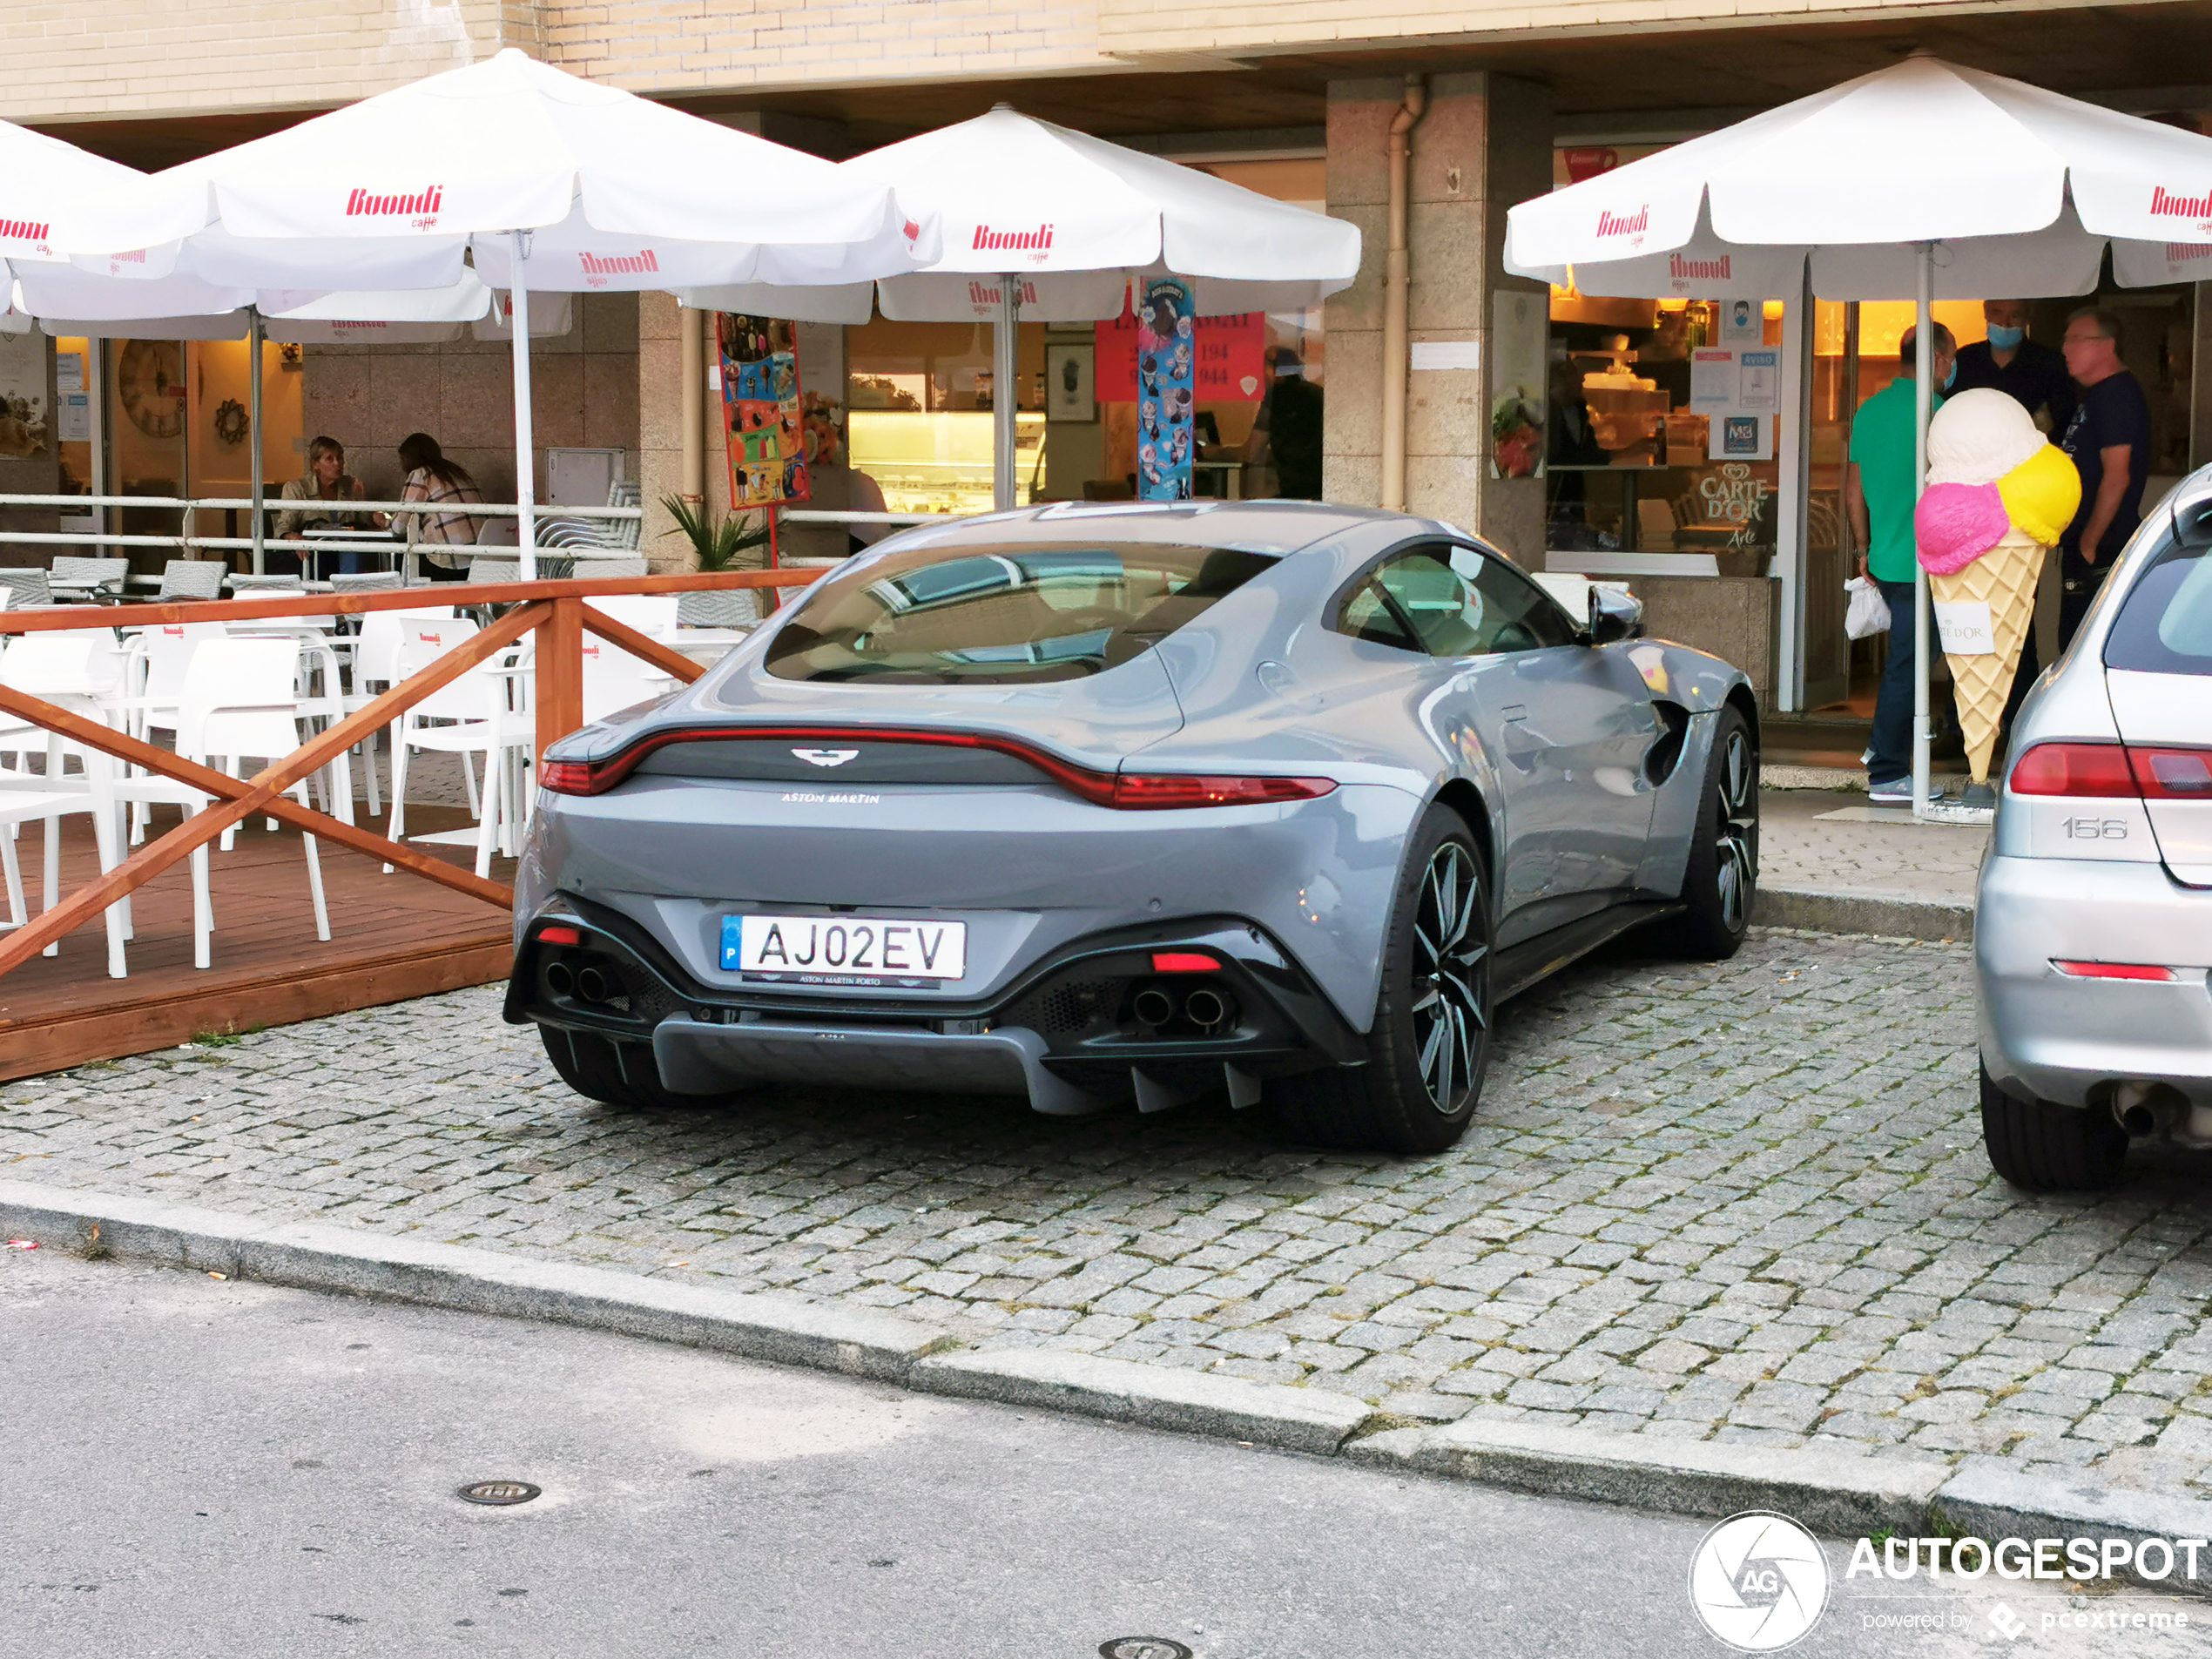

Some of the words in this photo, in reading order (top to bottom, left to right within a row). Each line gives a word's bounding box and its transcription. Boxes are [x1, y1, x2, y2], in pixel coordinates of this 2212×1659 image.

[346, 184, 443, 216] Buondi
[2150, 185, 2212, 218] Buond
[0, 219, 50, 240] uon
[1596, 204, 1649, 238] Buondi
[2196, 220, 2212, 235] caff
[972, 223, 1054, 250] Buondi
[1700, 476, 1769, 501] CARTE
[1708, 499, 1764, 523] D'OR
[1725, 527, 1757, 550] Arte
[1954, 626, 1987, 640] D'OR
[781, 792, 825, 803] ASTON
[826, 793, 880, 804] MARTIN
[2060, 816, 2128, 840] 156
[726, 948, 736, 960] P
[759, 922, 945, 970] AJ02EV
